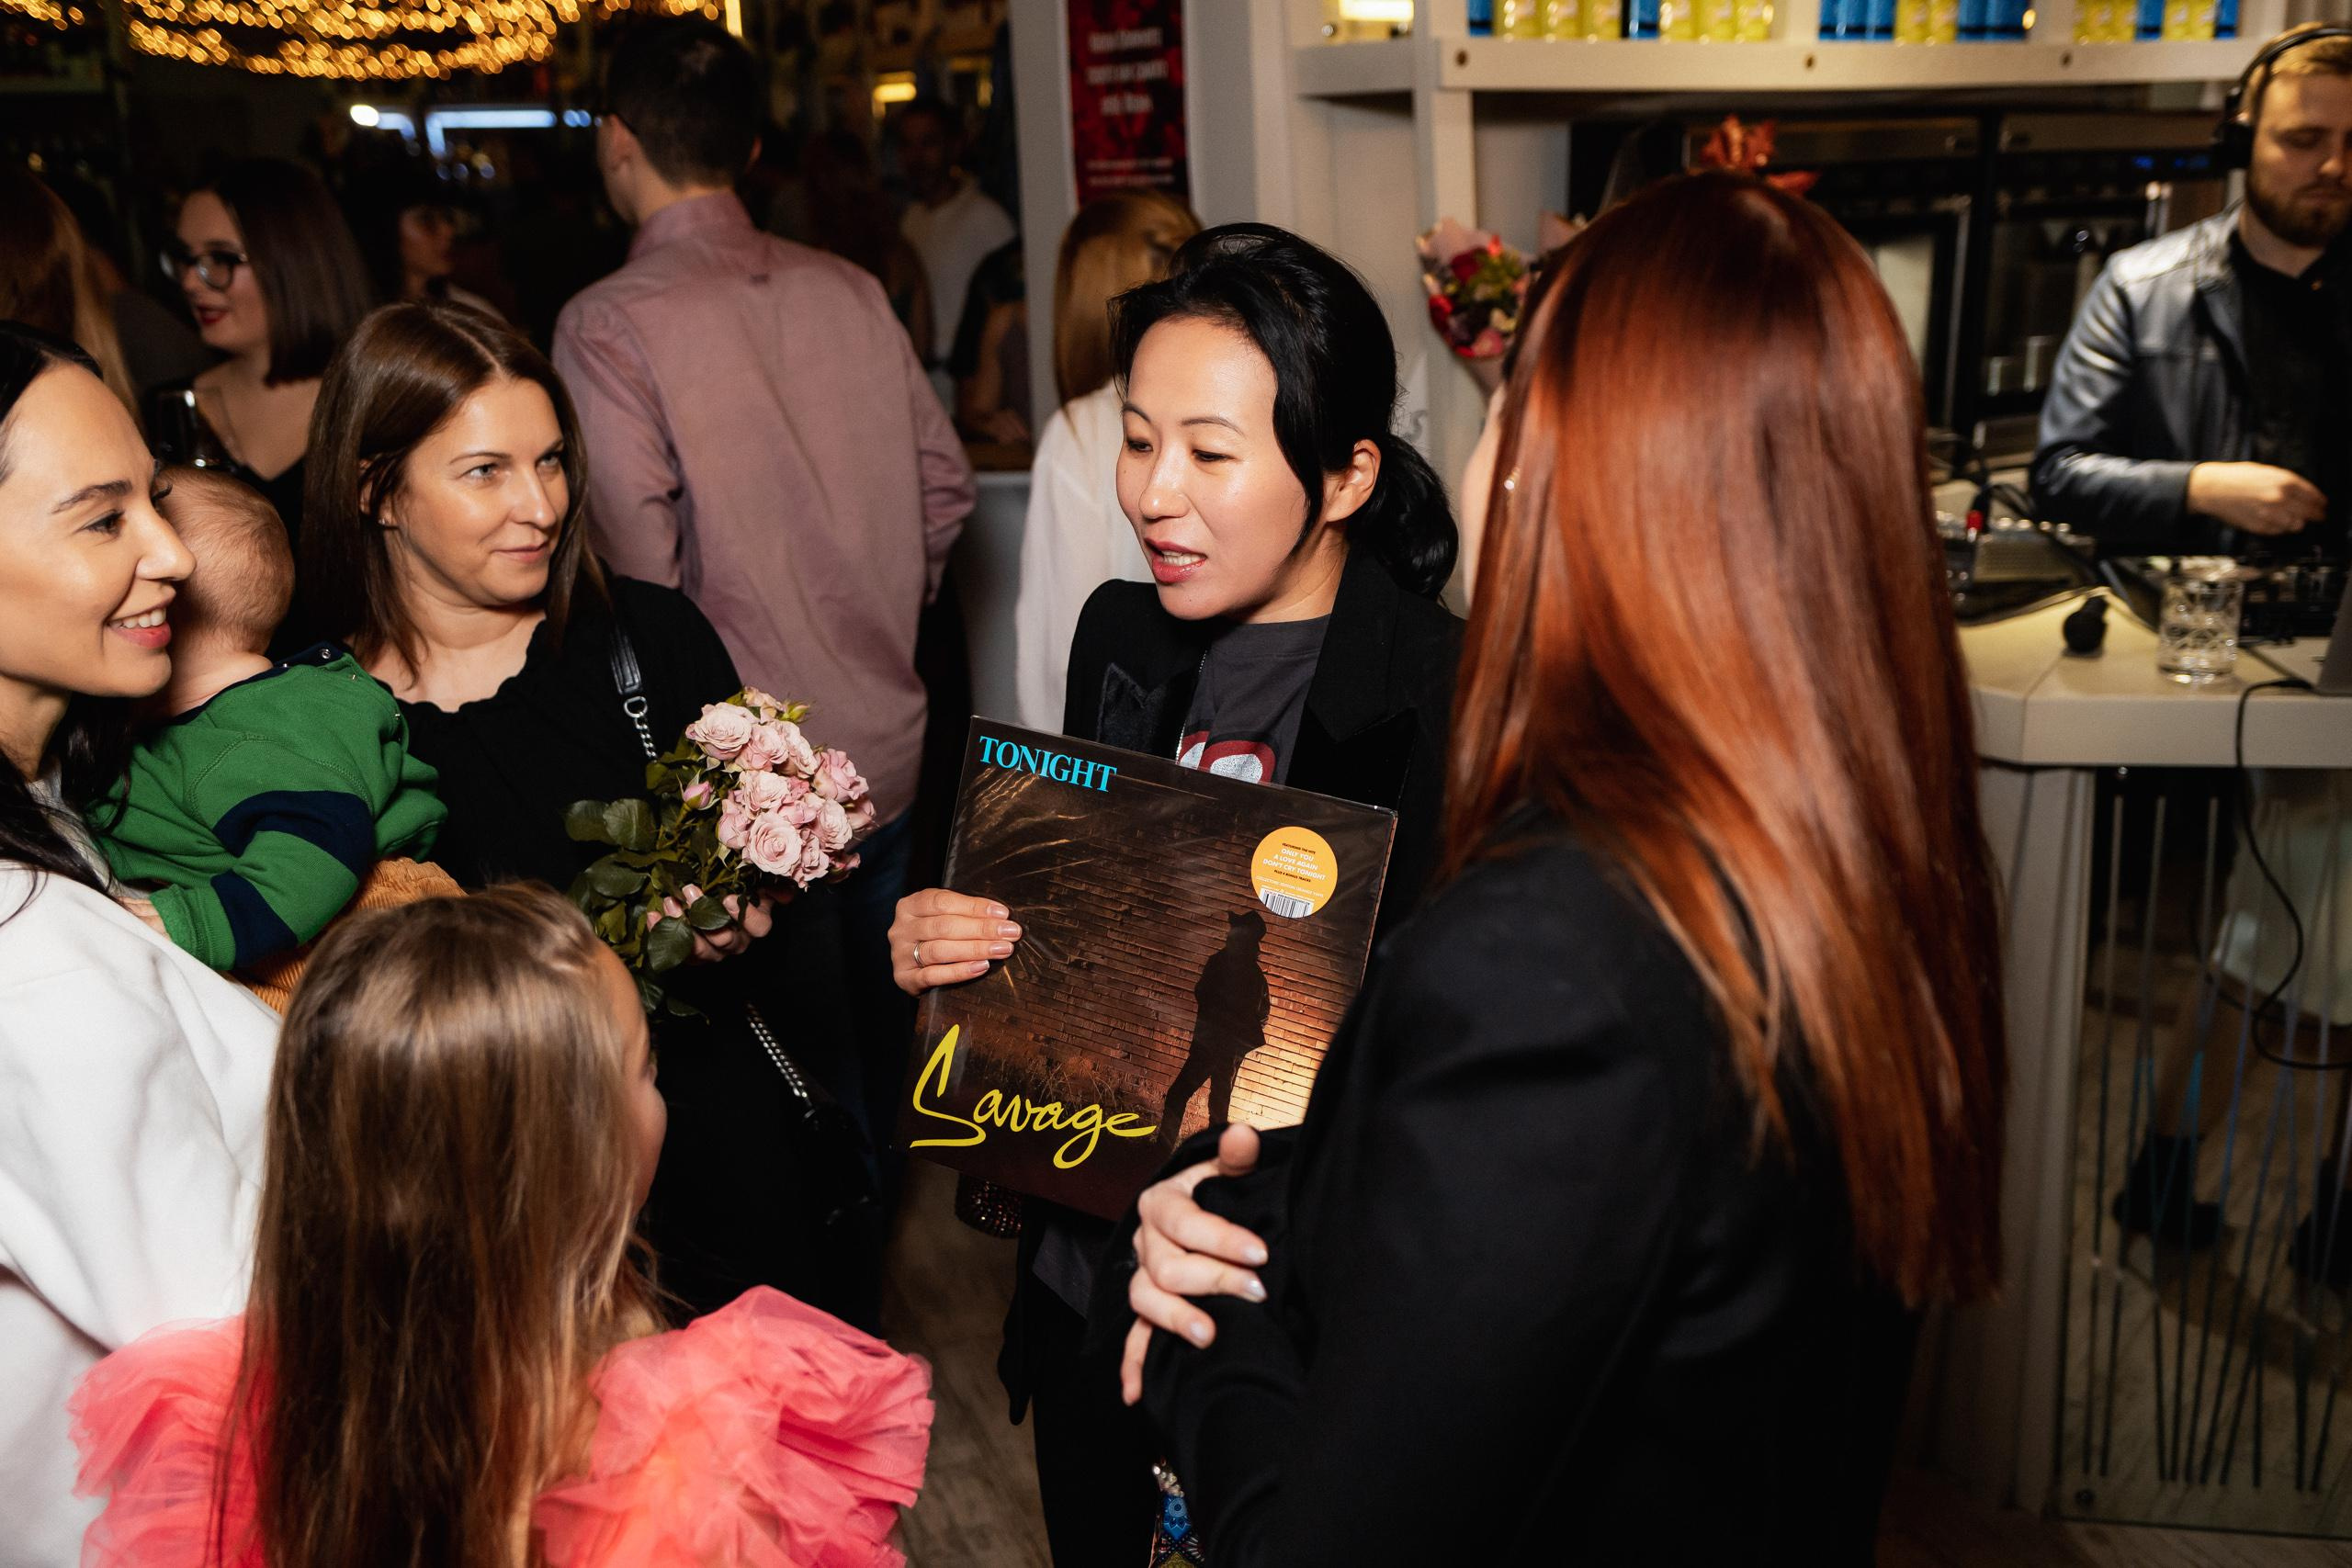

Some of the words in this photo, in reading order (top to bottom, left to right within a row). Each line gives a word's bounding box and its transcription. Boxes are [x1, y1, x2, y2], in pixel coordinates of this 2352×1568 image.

[979, 736, 1117, 793] TONIGHT
[1281, 848, 1299, 857] ONLY
[1300, 853, 1314, 862] YOU
[1296, 860, 1318, 871] AGAIN
[1262, 858, 1283, 868] DON'T
[1296, 867, 1326, 880] TONIGHT
[910, 1024, 1157, 1169] Savage
